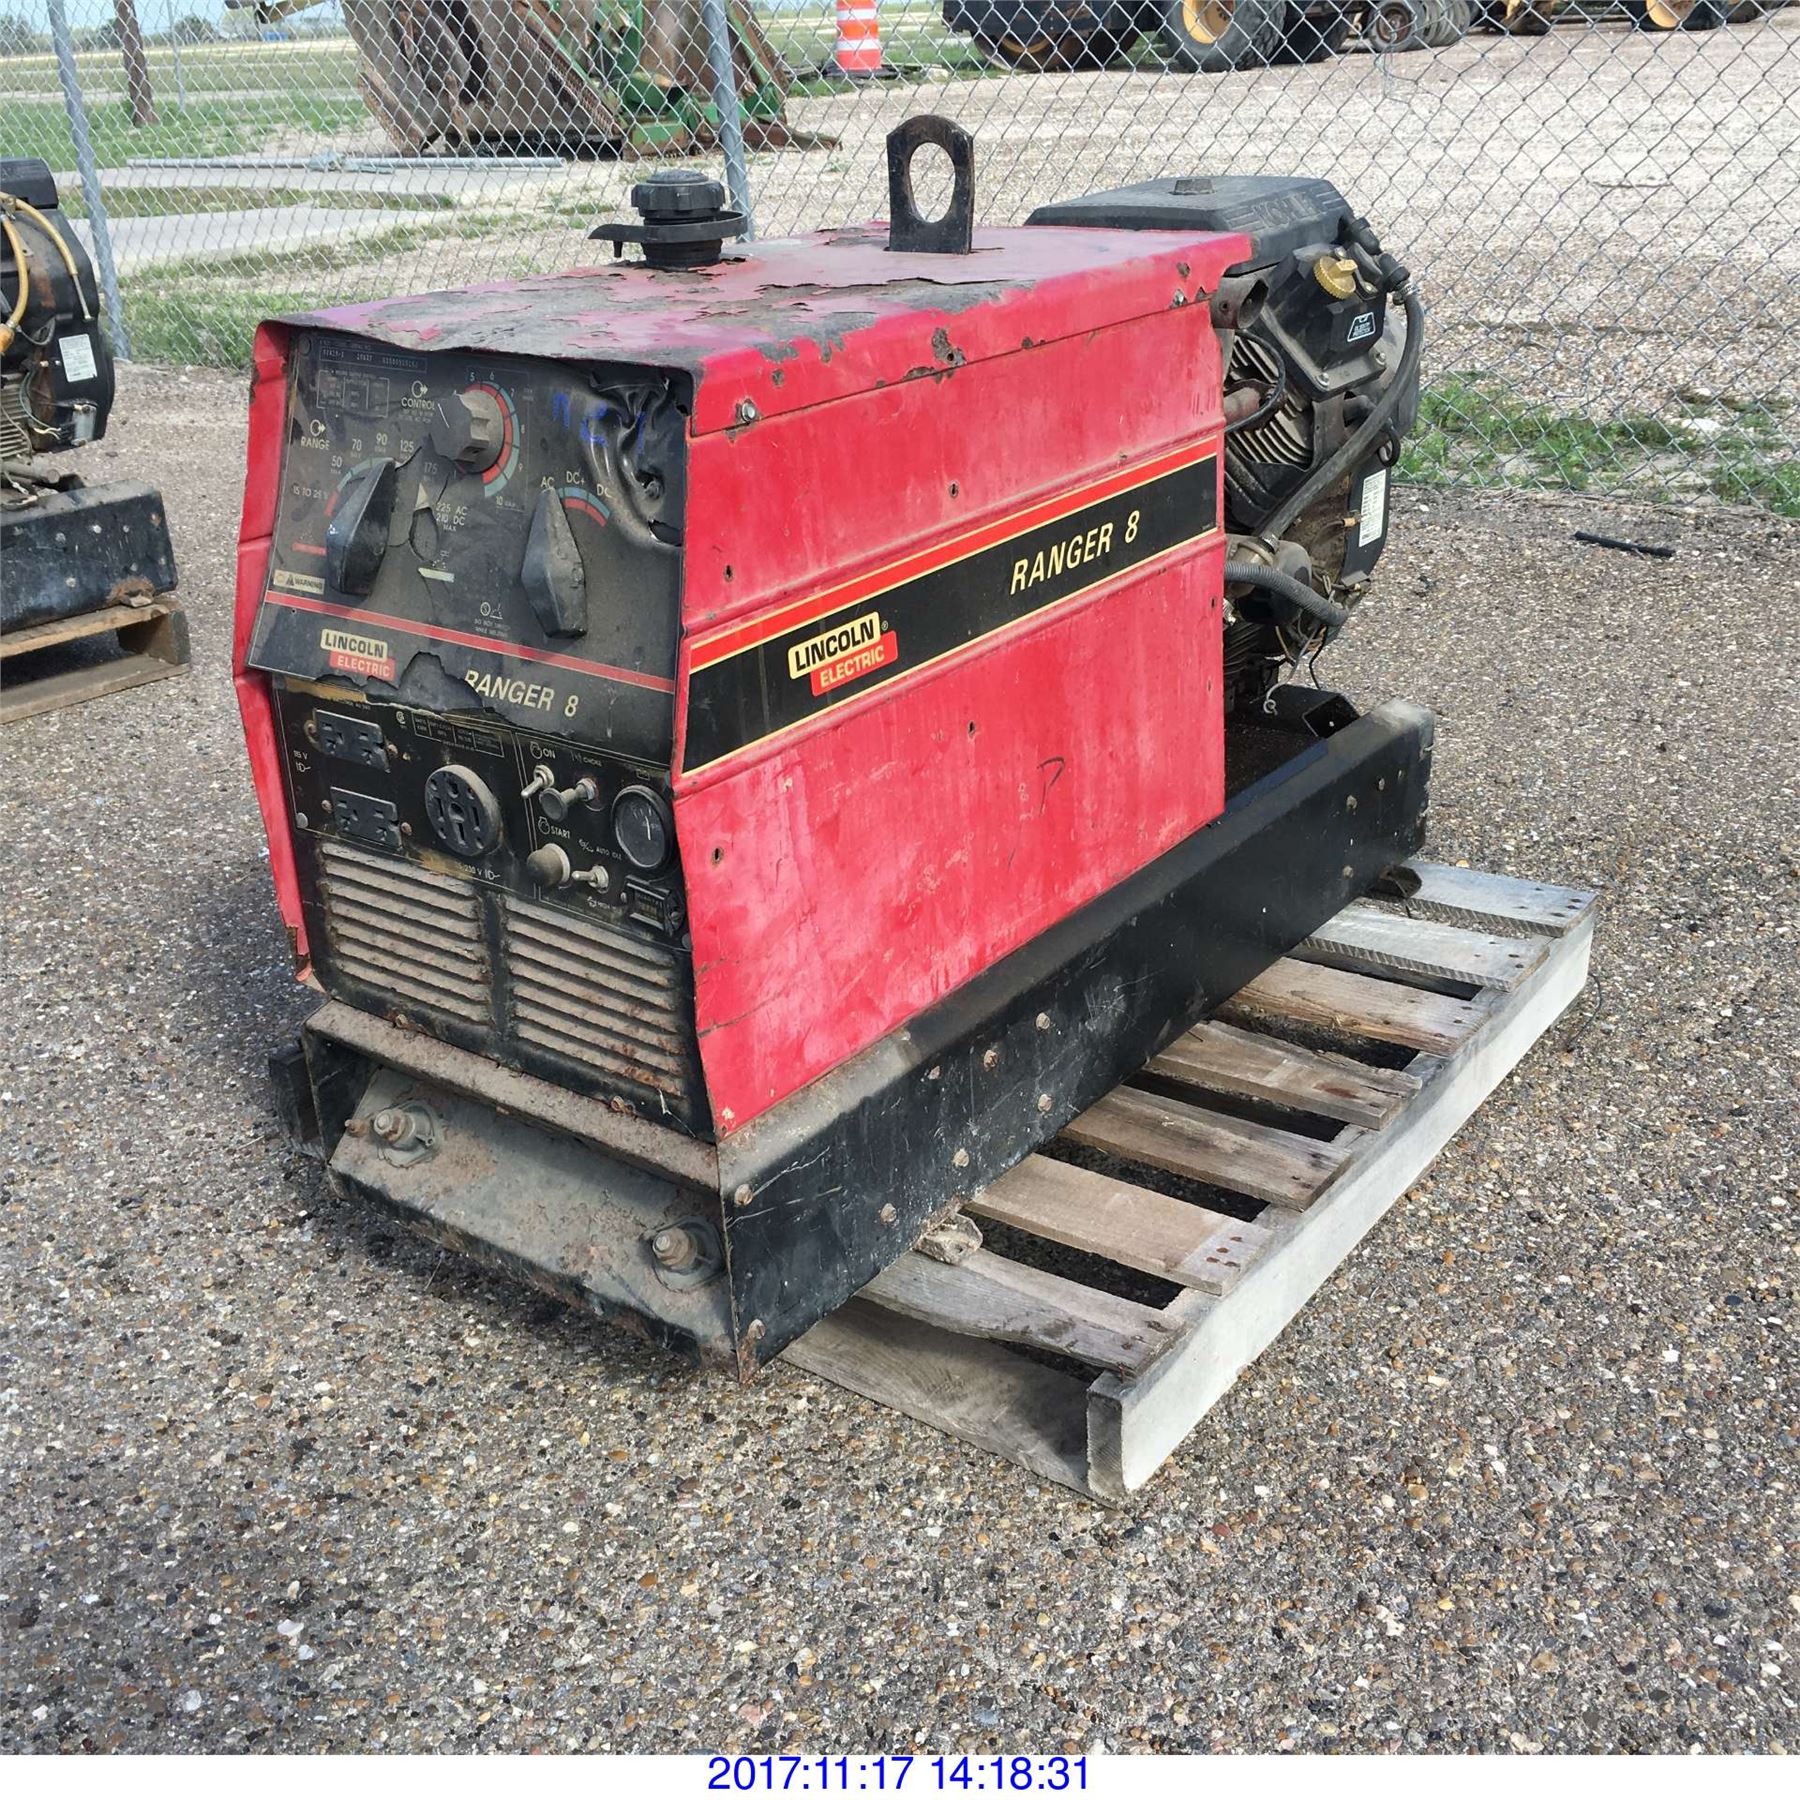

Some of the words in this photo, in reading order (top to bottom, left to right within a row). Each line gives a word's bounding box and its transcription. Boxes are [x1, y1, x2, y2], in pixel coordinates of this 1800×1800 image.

[401, 397, 435, 410] CONTROL
[301, 436, 330, 450] RANGE
[352, 439, 362, 451] 70
[376, 432, 388, 446] 90
[400, 440, 414, 453] 125
[331, 456, 342, 468] 50
[424, 462, 438, 475] 175
[541, 476, 555, 488] AC
[436, 502, 451, 512] 225
[456, 506, 468, 516] AC
[453, 515, 465, 526] DC
[1009, 522, 1114, 595] RANGER
[1124, 510, 1140, 544] 8
[324, 632, 384, 658] LINCOLN
[795, 619, 875, 672] LINCOLN
[337, 655, 392, 677] ELECTRIC
[820, 645, 885, 688] ELECTRIC
[464, 669, 555, 711] RANGER
[564, 695, 579, 717] 8
[543, 750, 556, 759] ON
[550, 826, 571, 839] START
